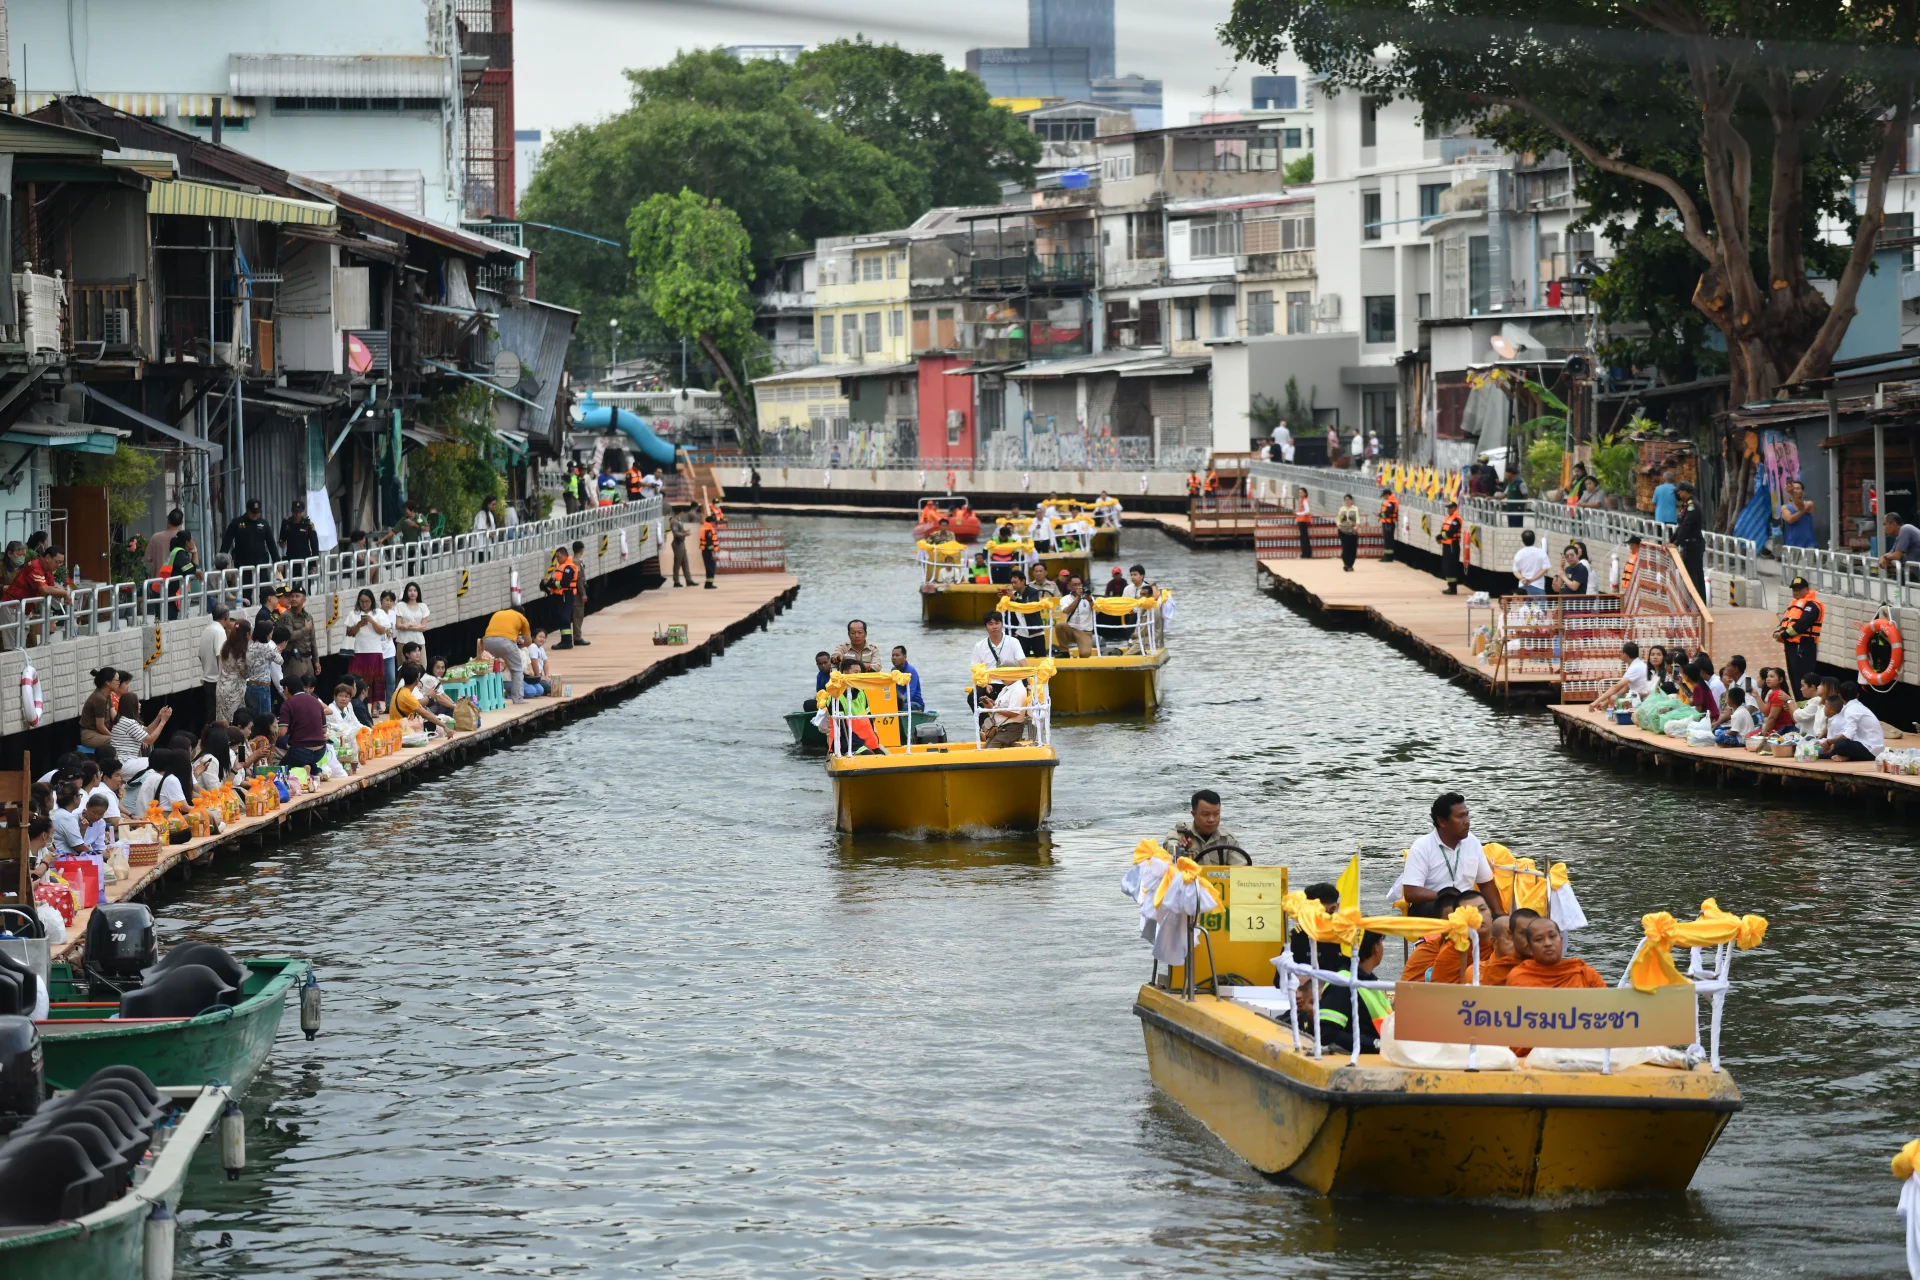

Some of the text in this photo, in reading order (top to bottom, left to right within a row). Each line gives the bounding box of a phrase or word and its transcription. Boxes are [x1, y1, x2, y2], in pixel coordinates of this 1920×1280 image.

[1246, 915, 1265, 930] 13
[111, 933, 127, 942] 70
[1457, 1000, 1639, 1030] วัดเปรมประชา
